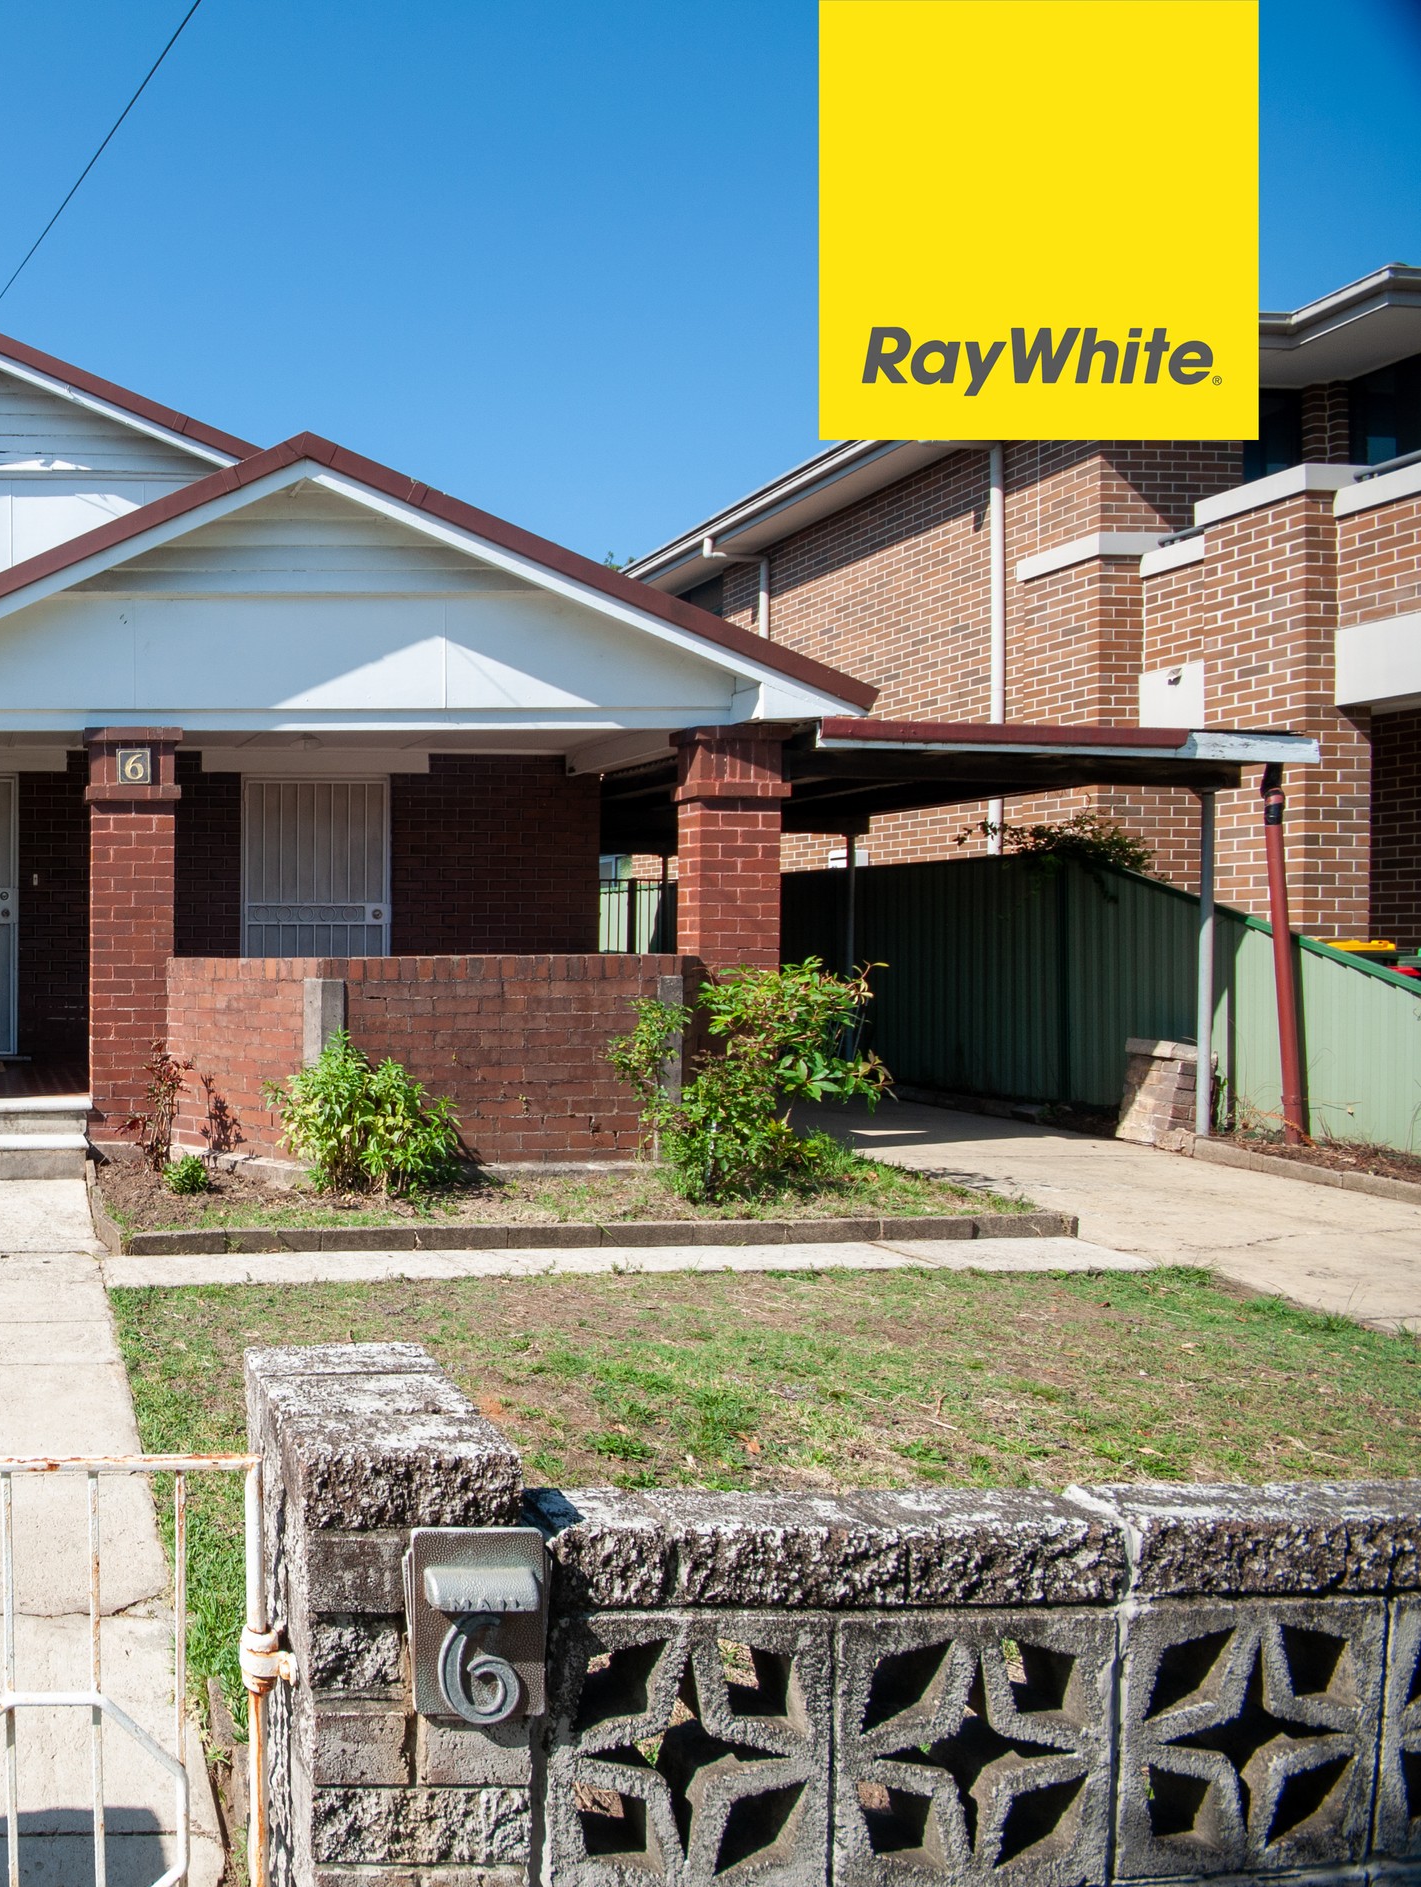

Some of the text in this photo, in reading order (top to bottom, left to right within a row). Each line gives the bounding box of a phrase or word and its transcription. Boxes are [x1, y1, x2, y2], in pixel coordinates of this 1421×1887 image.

[125, 754, 144, 779] 6
[449, 1597, 527, 1612] MAIL
[438, 1612, 521, 1725] 6
